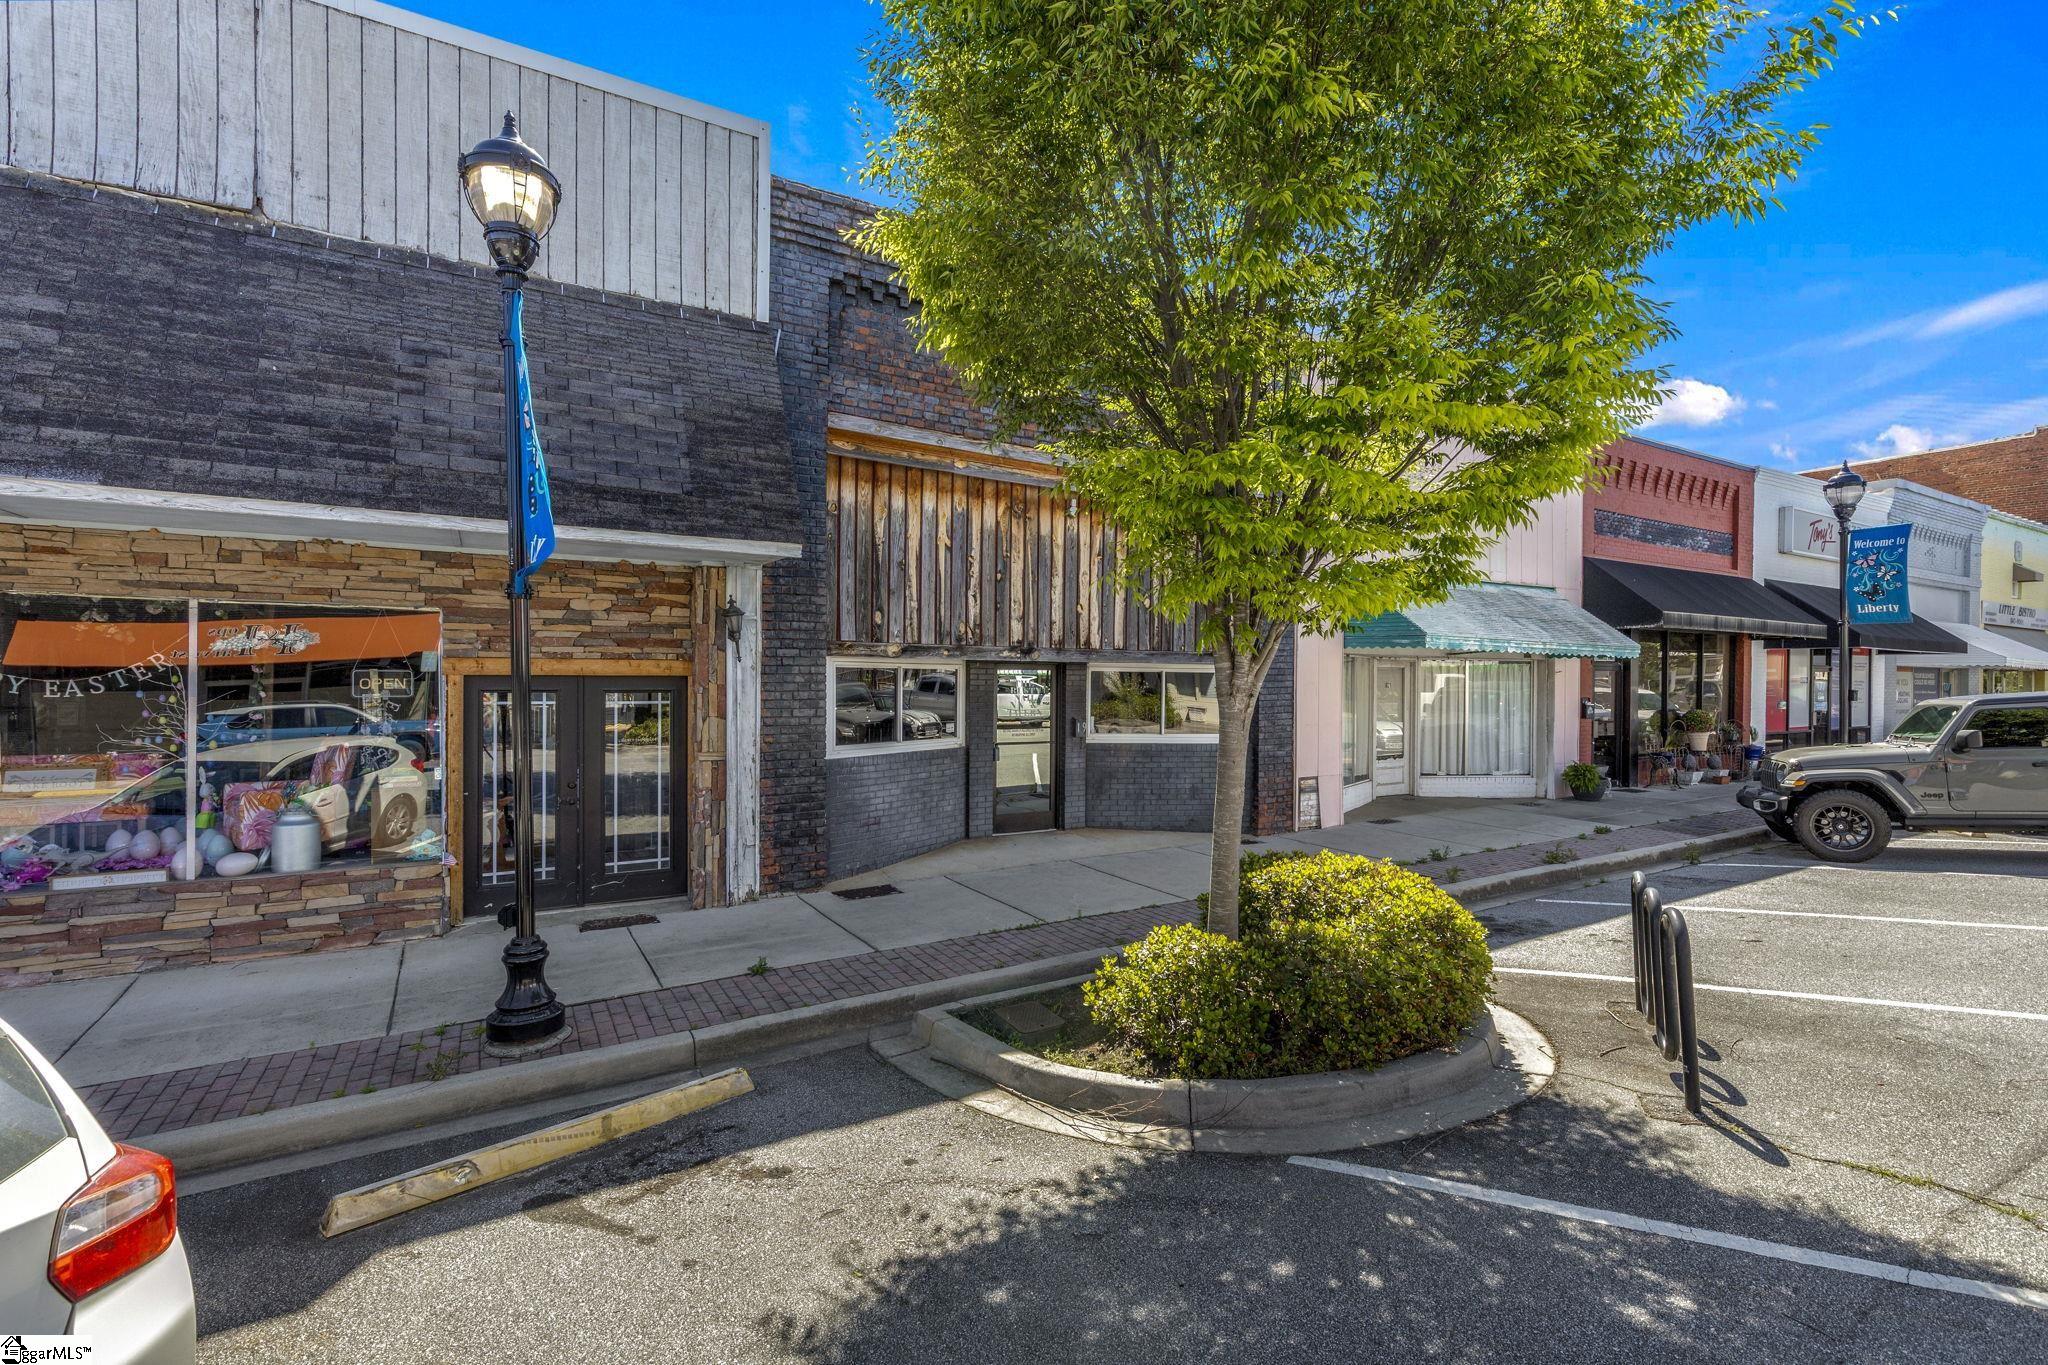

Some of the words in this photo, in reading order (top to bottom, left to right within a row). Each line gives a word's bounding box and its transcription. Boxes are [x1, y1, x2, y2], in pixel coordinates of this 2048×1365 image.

[1808, 519, 1836, 552] Tony's
[1854, 538, 1895, 549] Welcome
[1896, 536, 1906, 545] to
[1857, 603, 1900, 613] Liberty
[0, 673, 29, 695] Y
[43, 652, 174, 698] EASTER
[359, 678, 406, 690] OPEN
[1920, 791, 1944, 799] Jeep
